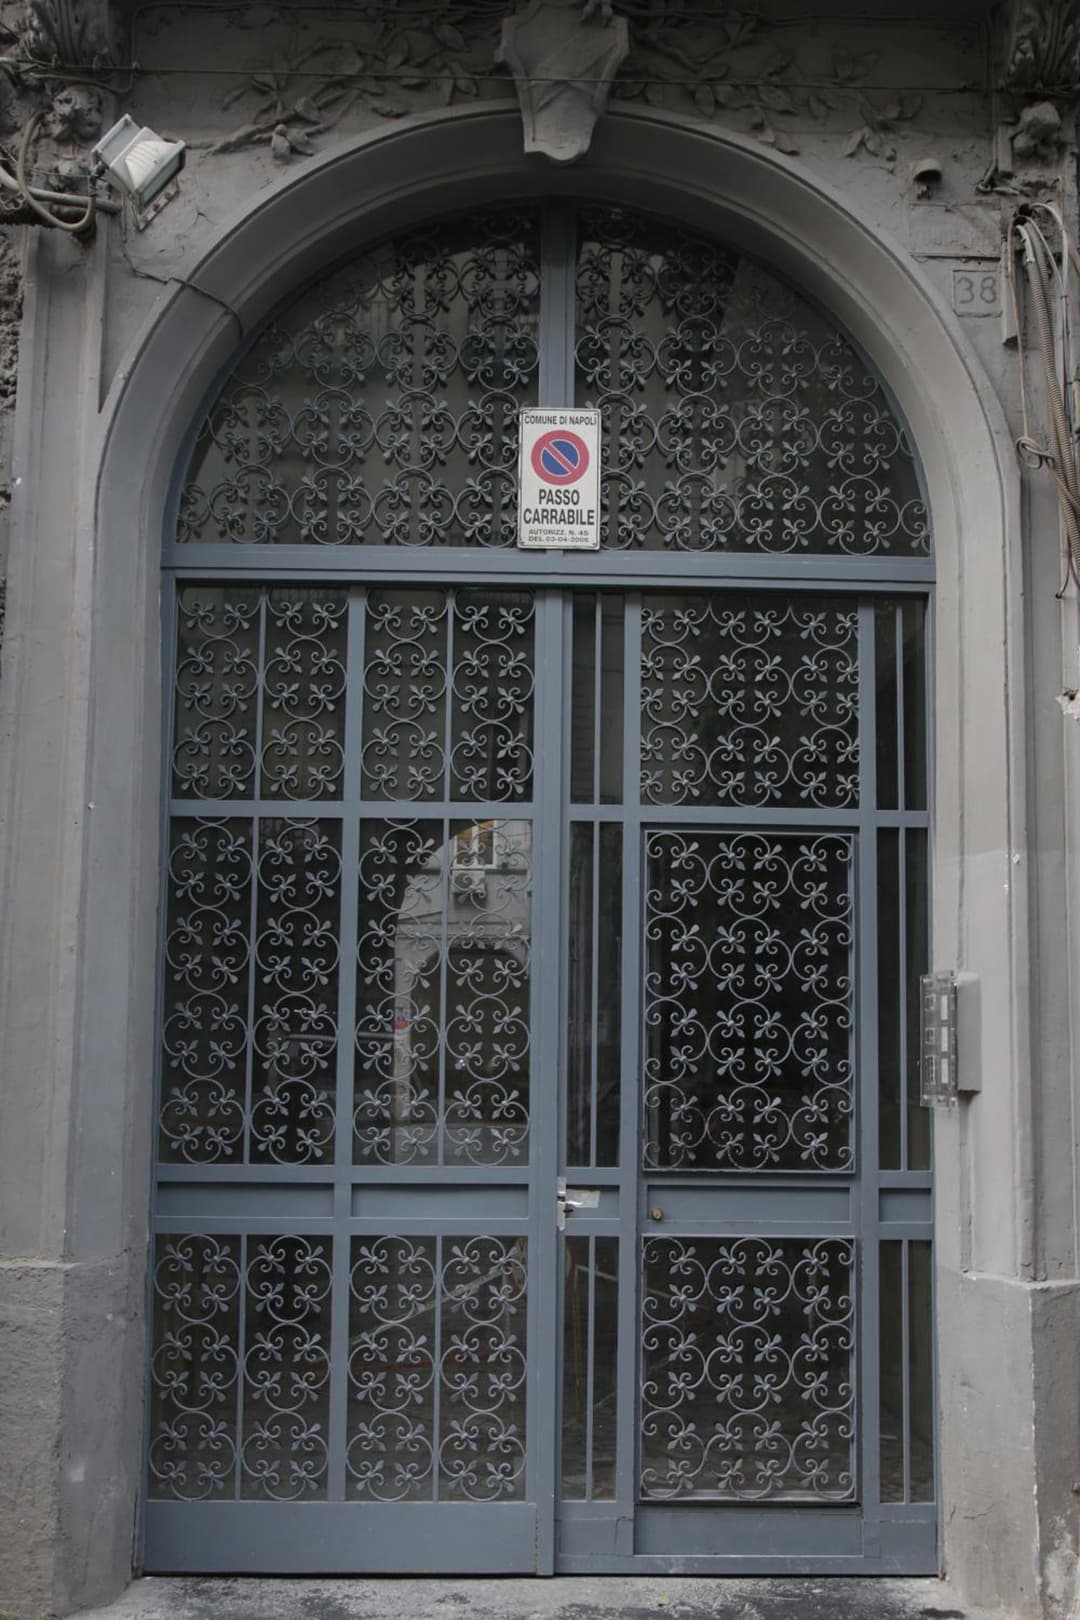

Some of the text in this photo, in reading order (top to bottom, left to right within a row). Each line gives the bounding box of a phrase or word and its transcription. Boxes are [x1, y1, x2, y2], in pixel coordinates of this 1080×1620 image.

[957, 276, 997, 304] 38
[524, 415, 597, 426] COMUNE DI NAPOLI
[538, 489, 580, 506] PASSO
[523, 508, 595, 526] CARRABILE
